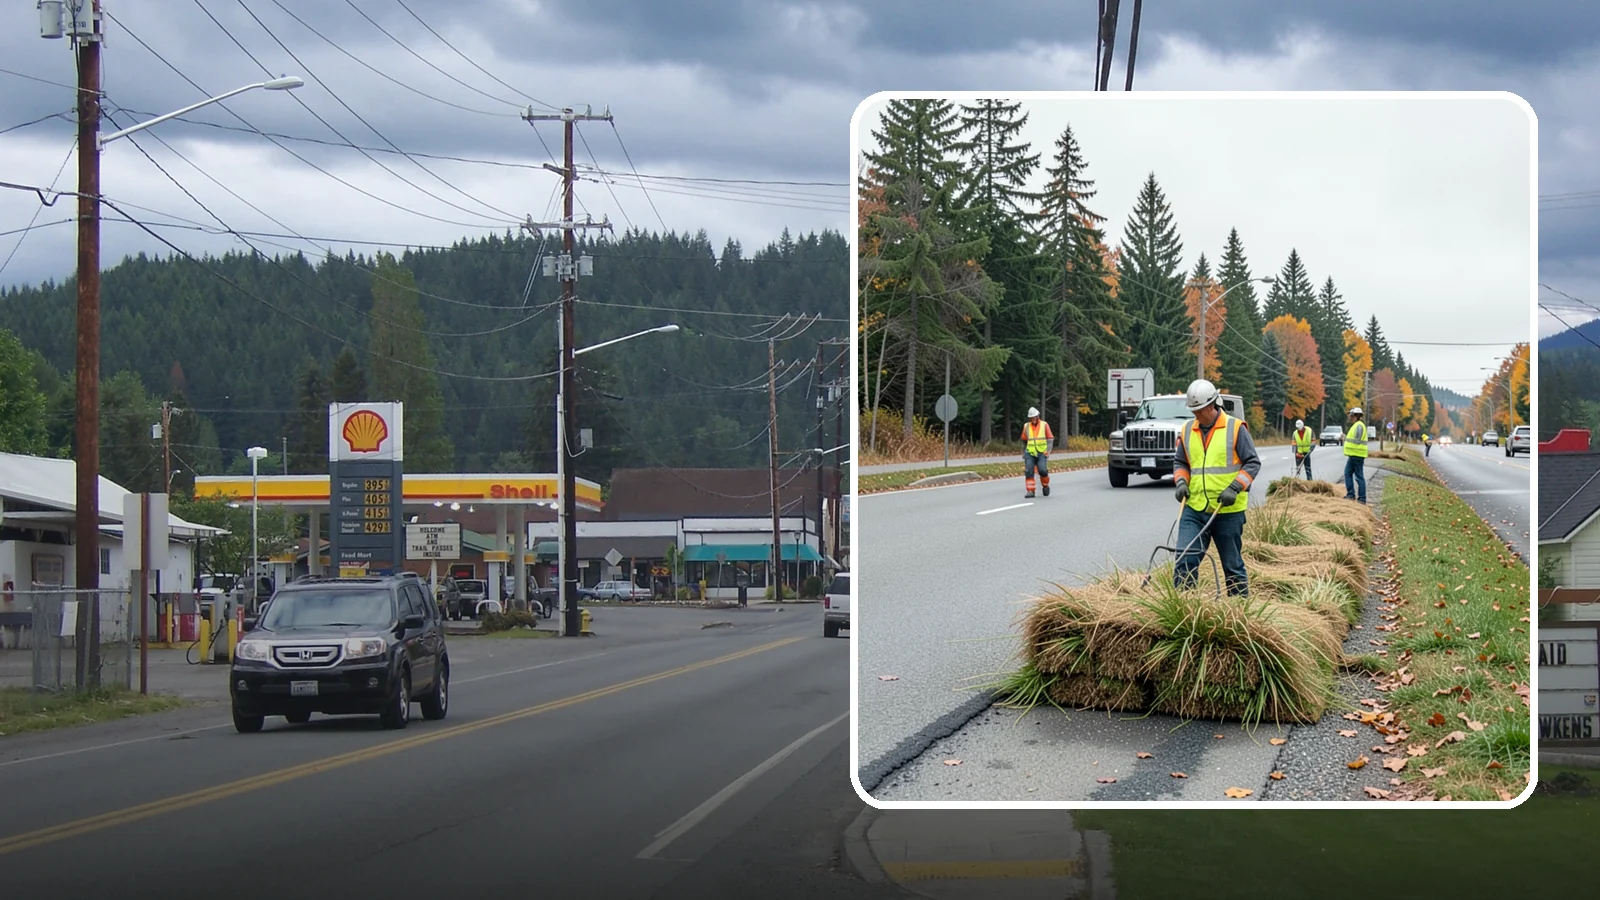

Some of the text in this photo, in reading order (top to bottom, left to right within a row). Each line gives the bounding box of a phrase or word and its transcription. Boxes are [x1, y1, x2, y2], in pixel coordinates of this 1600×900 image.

[366, 480, 384, 490] 395
[490, 484, 547, 499] Shell
[366, 494, 384, 504] 405
[366, 508, 384, 518] 415
[366, 522, 384, 532] 429
[1539, 643, 1566, 665] AID
